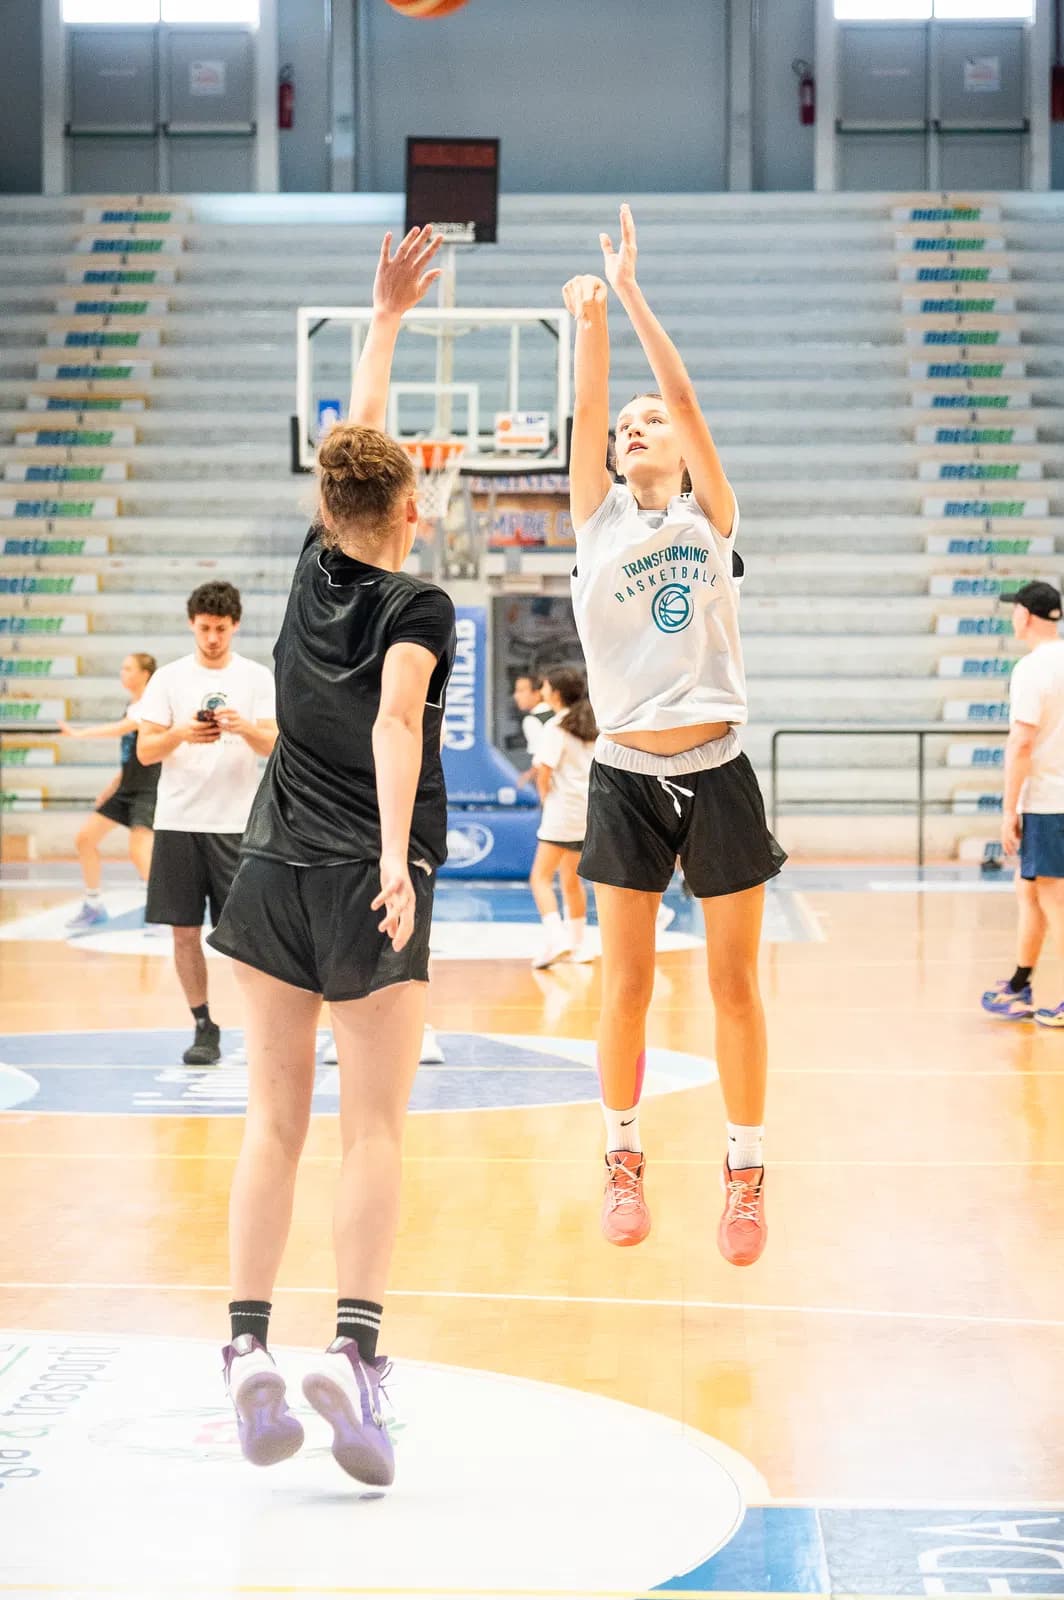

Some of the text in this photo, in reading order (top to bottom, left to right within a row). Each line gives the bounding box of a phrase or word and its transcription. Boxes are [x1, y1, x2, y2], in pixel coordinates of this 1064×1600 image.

[945, 501, 1025, 517] metamer
[950, 538, 1029, 555] metamer
[622, 545, 709, 578] TRANSFORMING
[614, 566, 718, 604] BASKETBALL
